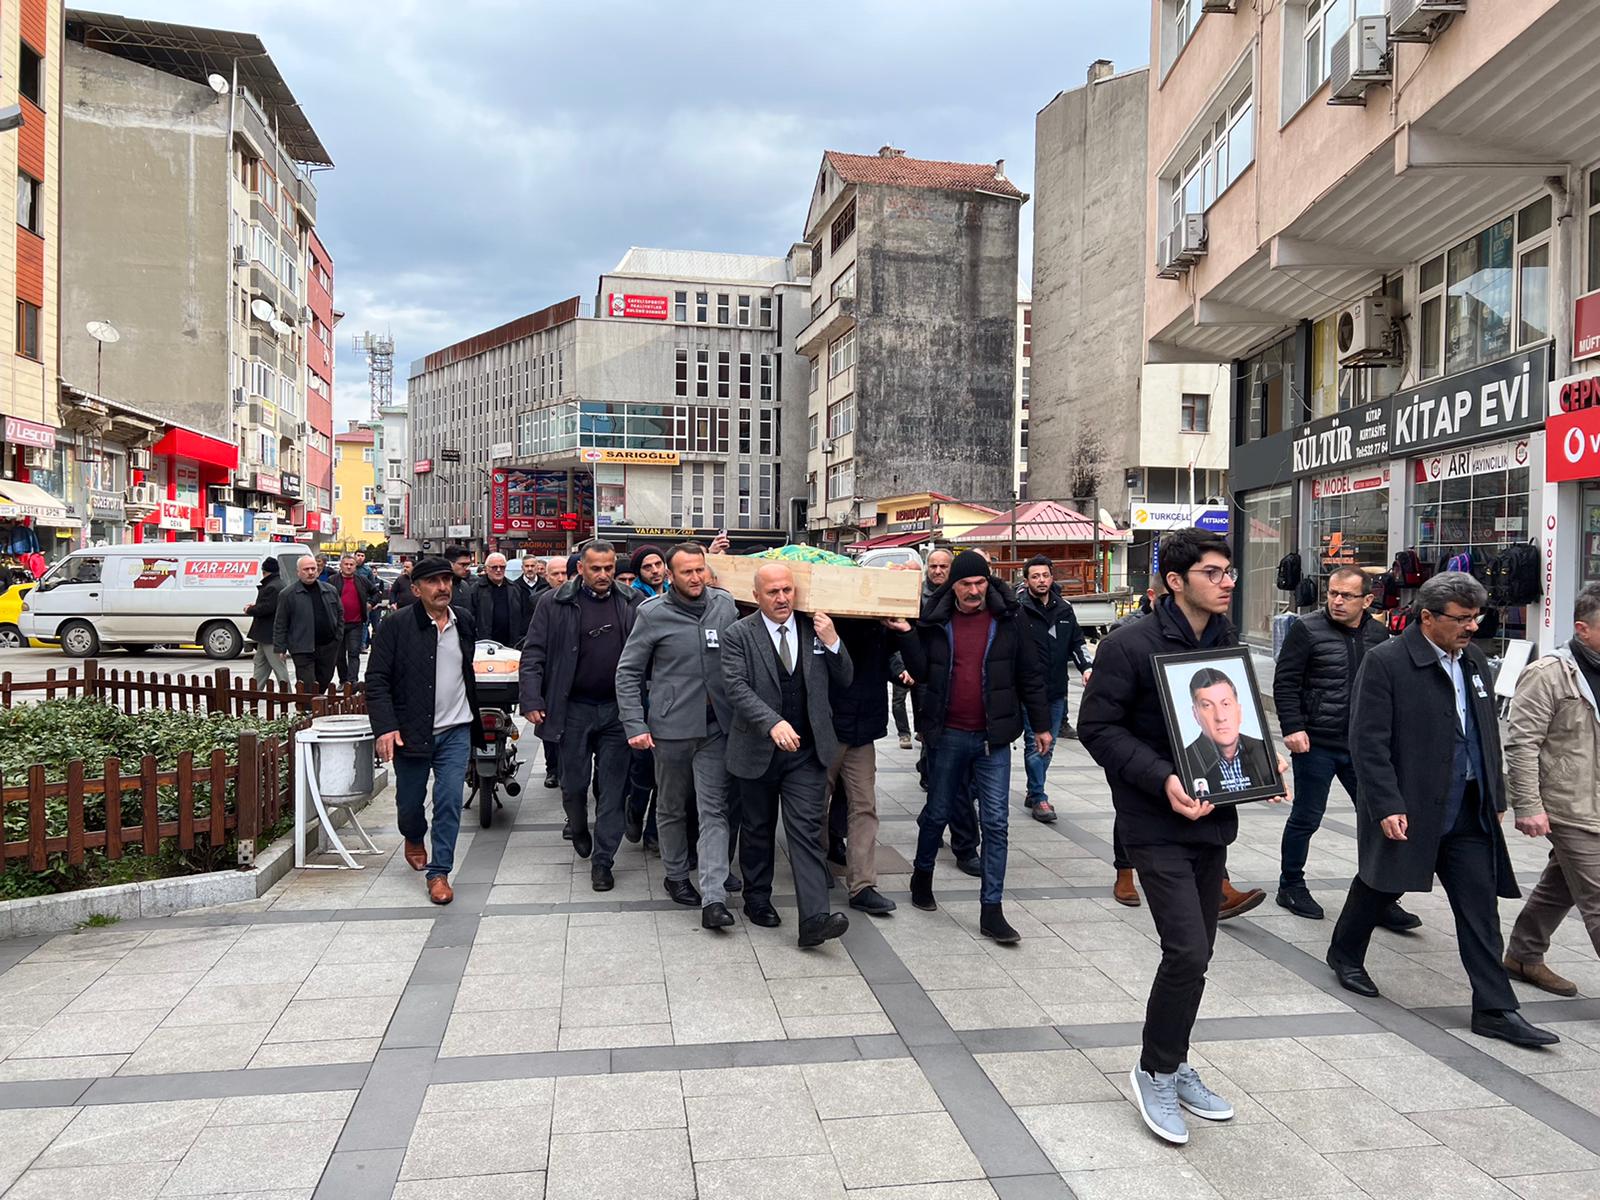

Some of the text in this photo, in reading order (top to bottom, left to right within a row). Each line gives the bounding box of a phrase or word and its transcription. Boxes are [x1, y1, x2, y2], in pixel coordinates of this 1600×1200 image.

[1579, 336, 1600, 353] MÜFT
[1394, 361, 1531, 446] KİTAP EVİ
[1366, 408, 1381, 423] KİTAP
[1293, 418, 1352, 473] KÜLTÜR
[1324, 476, 1351, 496] MODEL
[1150, 512, 1191, 521] TURKCELL
[190, 562, 251, 574] KAR-PAN
[1545, 538, 1553, 628] vodafone
